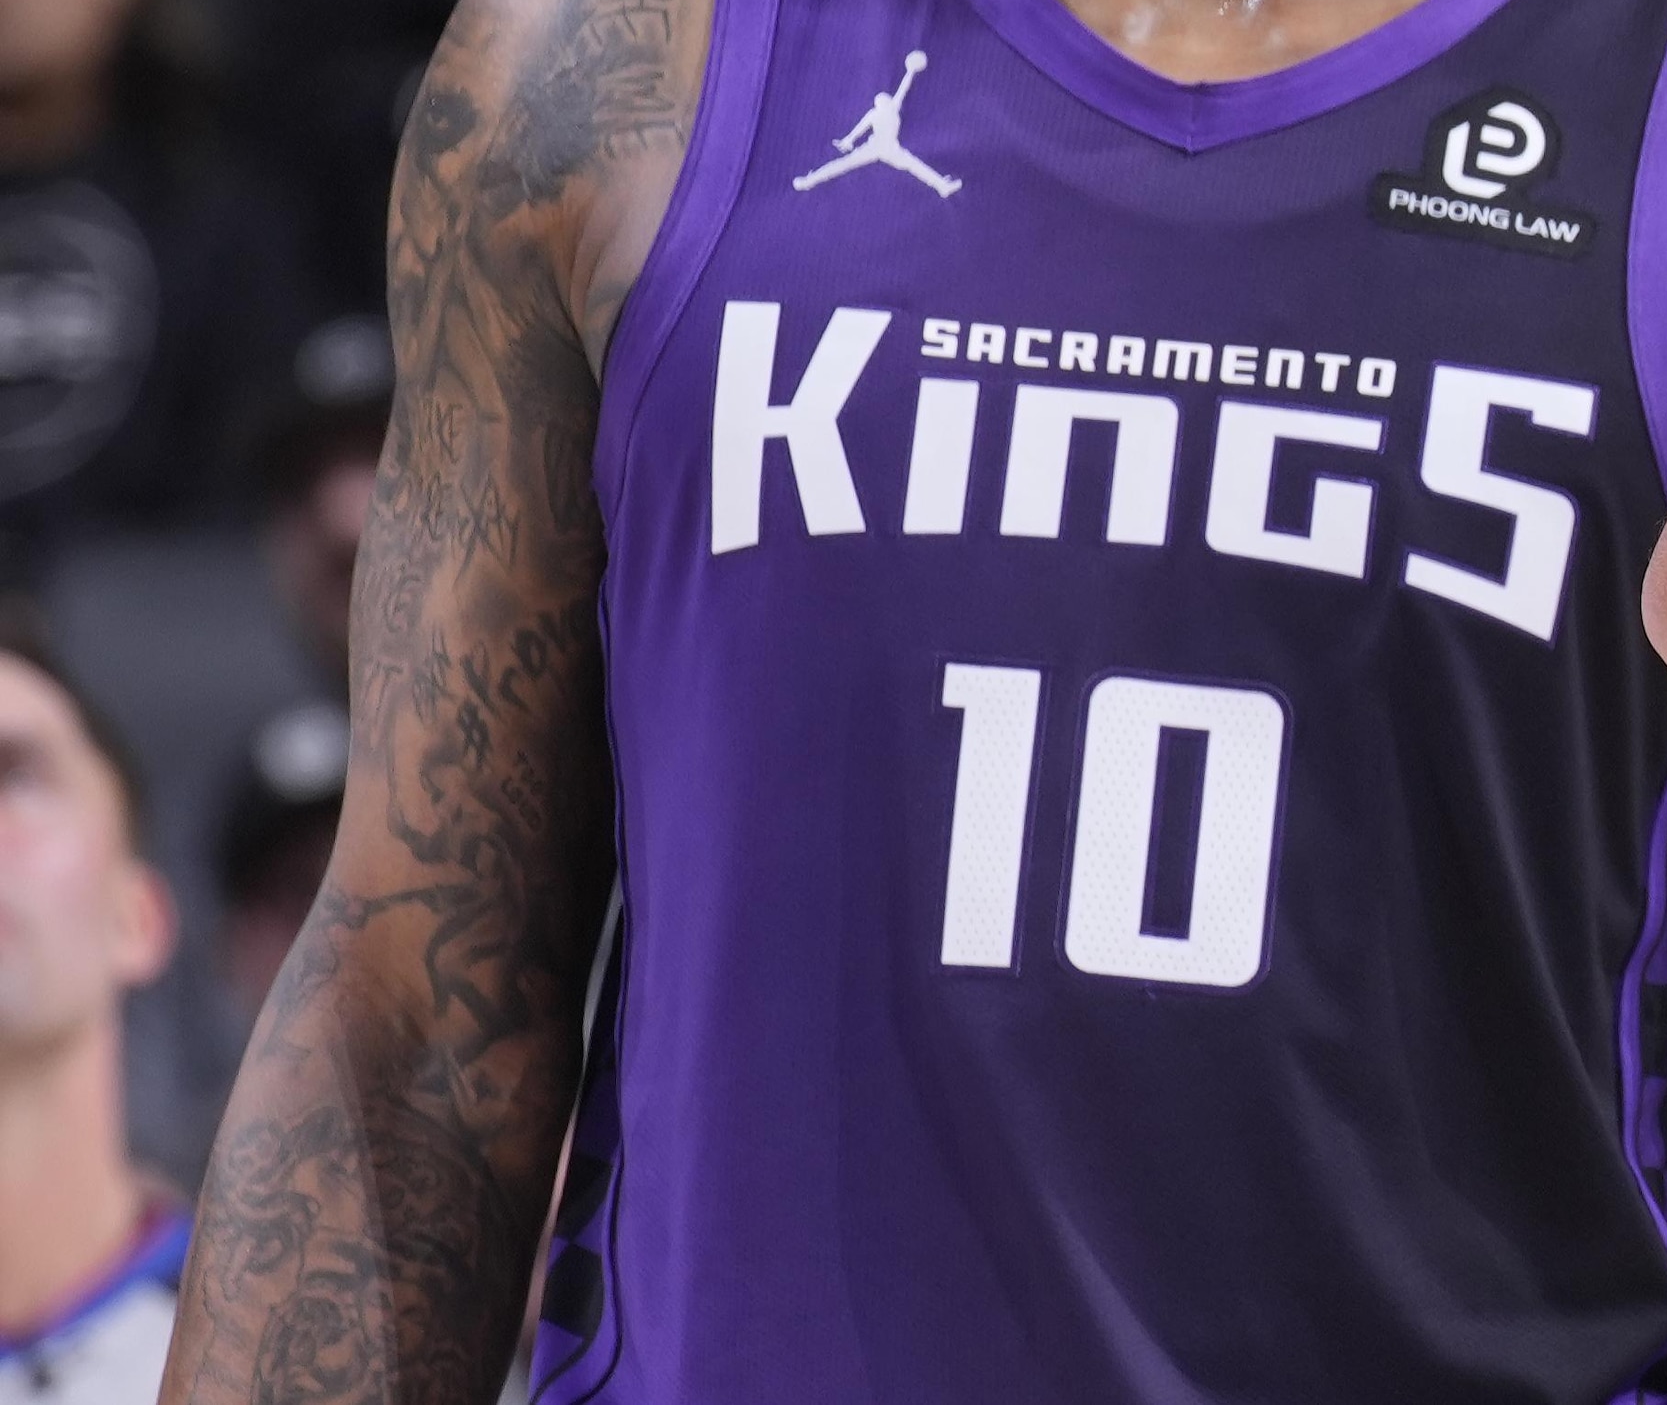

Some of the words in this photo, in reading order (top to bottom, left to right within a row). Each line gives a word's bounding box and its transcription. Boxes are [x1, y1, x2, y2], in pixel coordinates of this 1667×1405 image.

[1389, 187, 1510, 230] PHOONG
[1515, 212, 1581, 243] LAW
[920, 317, 1397, 398] SACRAMENTO
[710, 300, 1596, 642] KINGS
[940, 662, 1286, 988] 10
